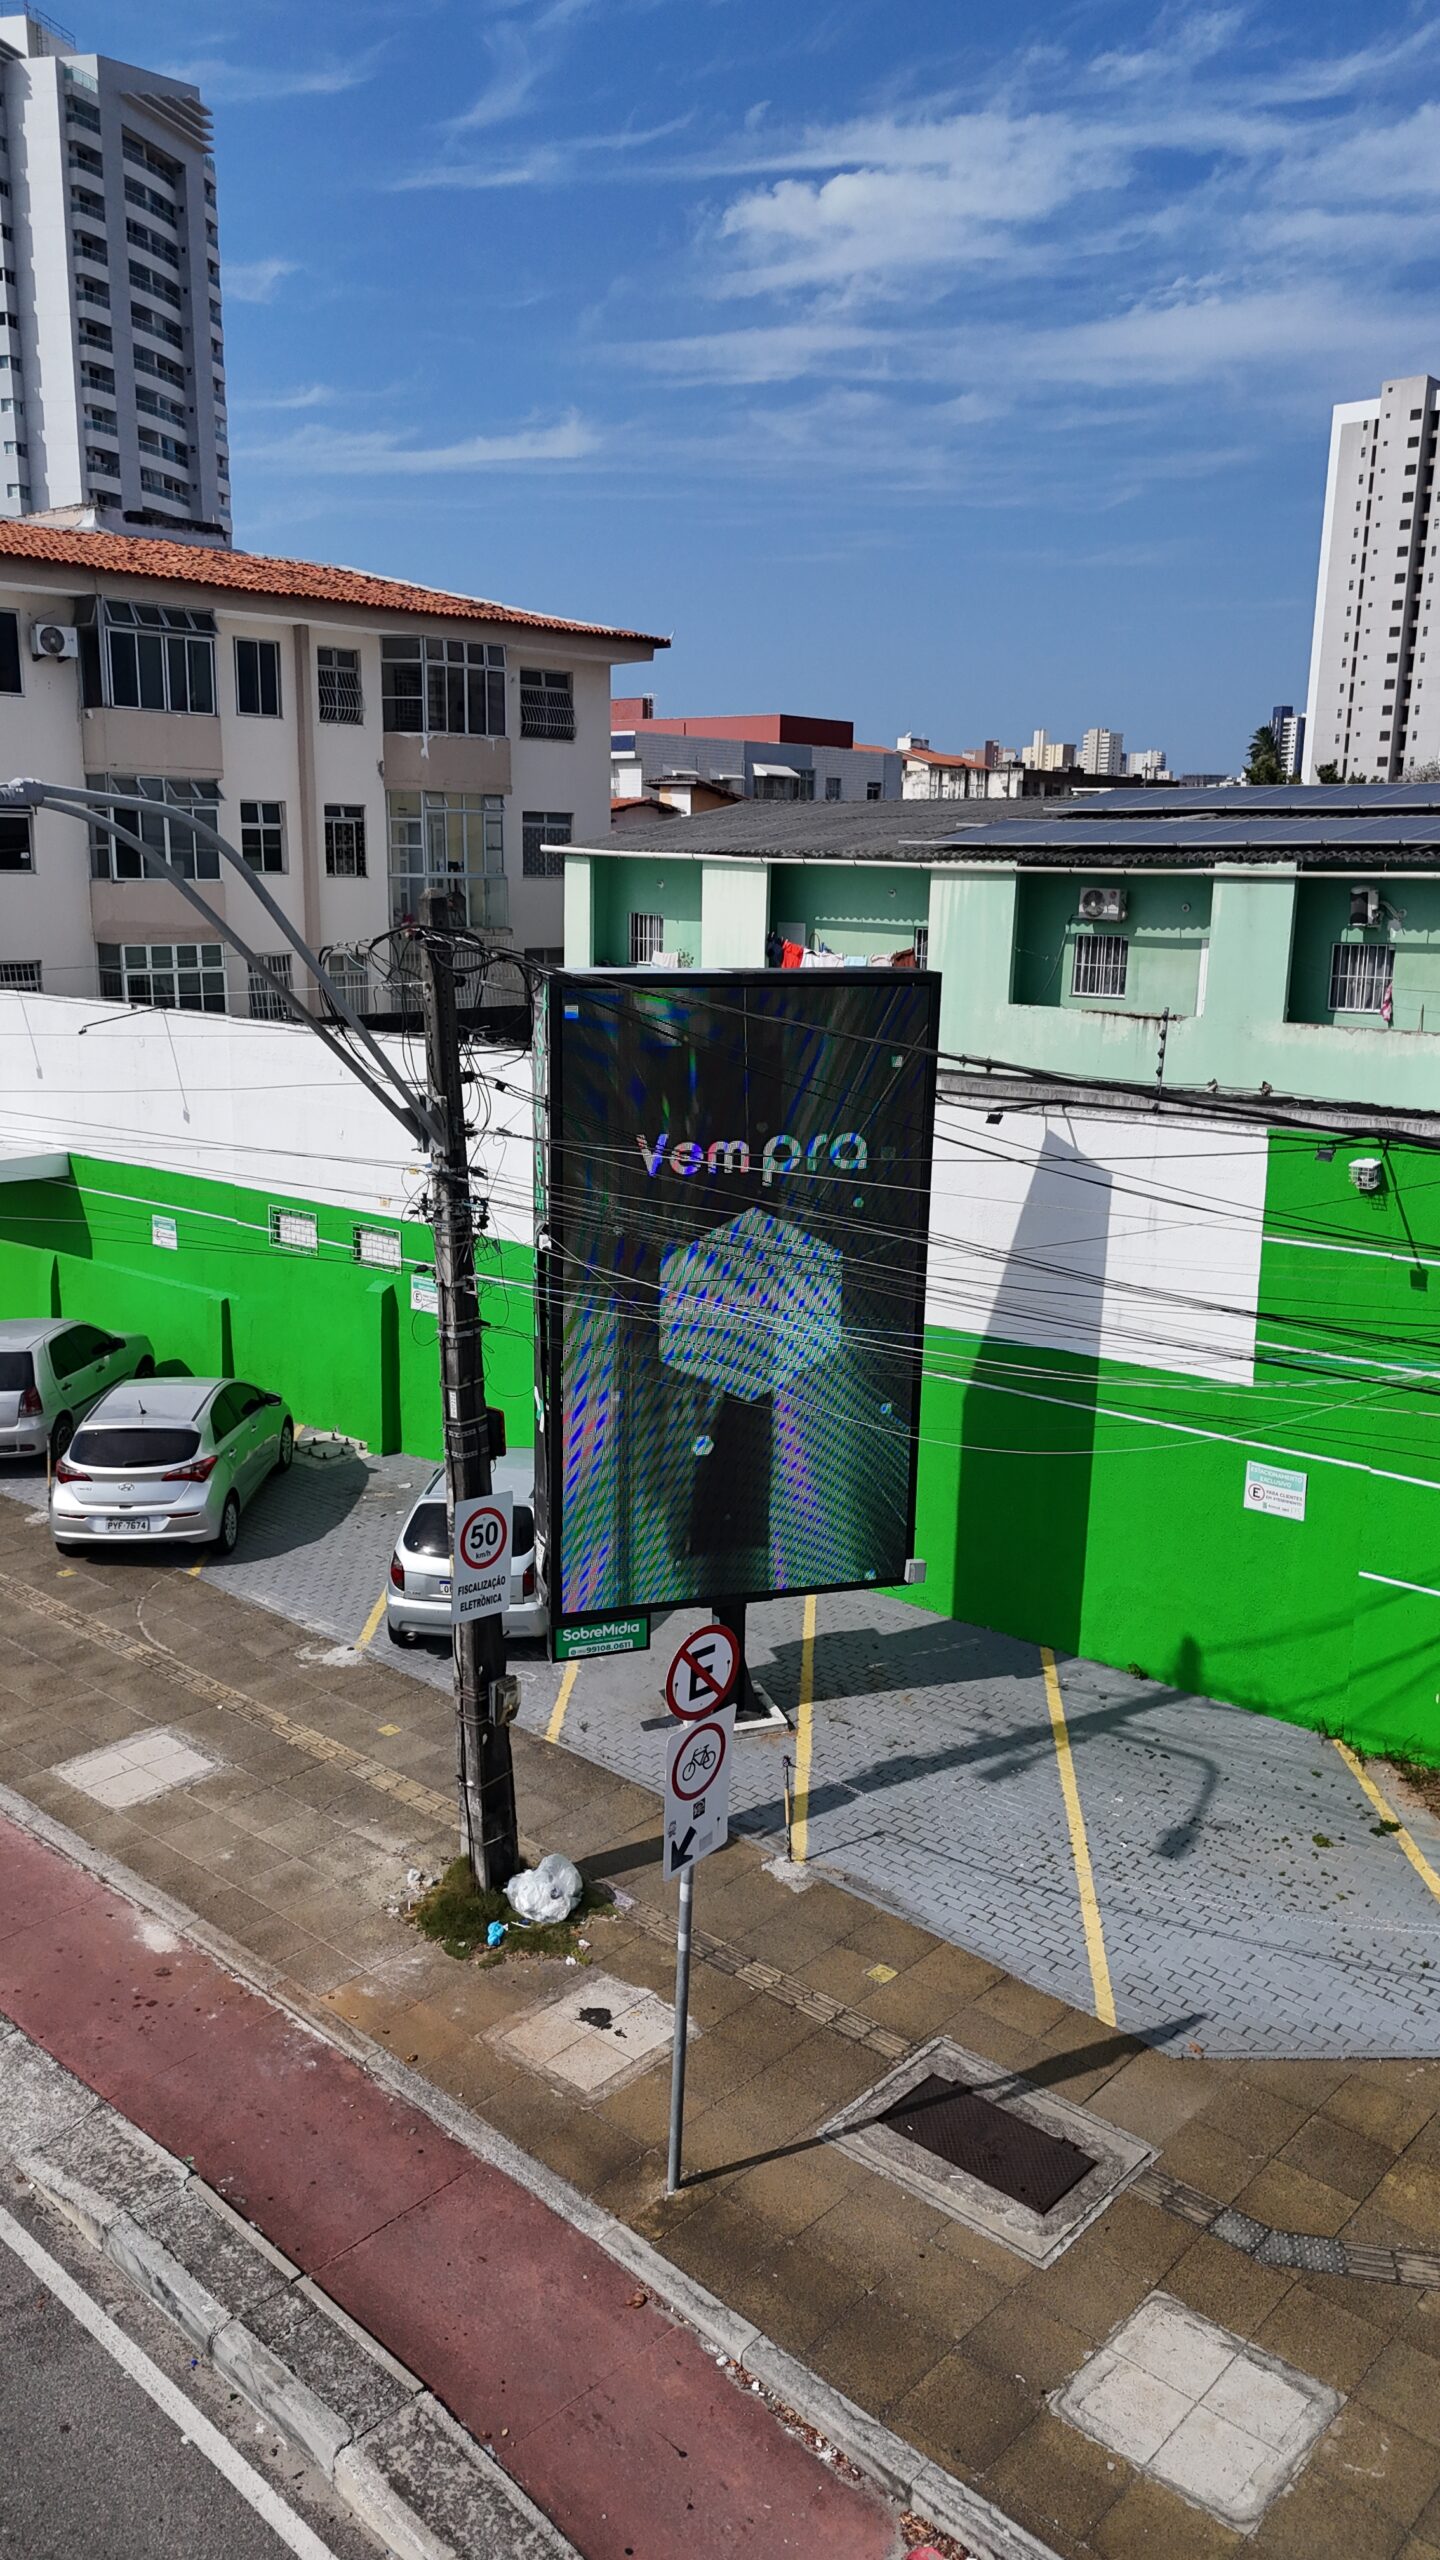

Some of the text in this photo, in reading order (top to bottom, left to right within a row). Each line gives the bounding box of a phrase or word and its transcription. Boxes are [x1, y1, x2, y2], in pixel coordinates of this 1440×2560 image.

[762, 1132, 868, 1187] pra
[1252, 1486, 1261, 1499] E
[470, 1521, 499, 1549] 50
[475, 1550, 491, 1559] km/h
[458, 1575, 506, 1596] FISCALIZAÇÃO
[460, 1593, 503, 1612] ELETRÔNICA
[688, 1643, 716, 1701] E
